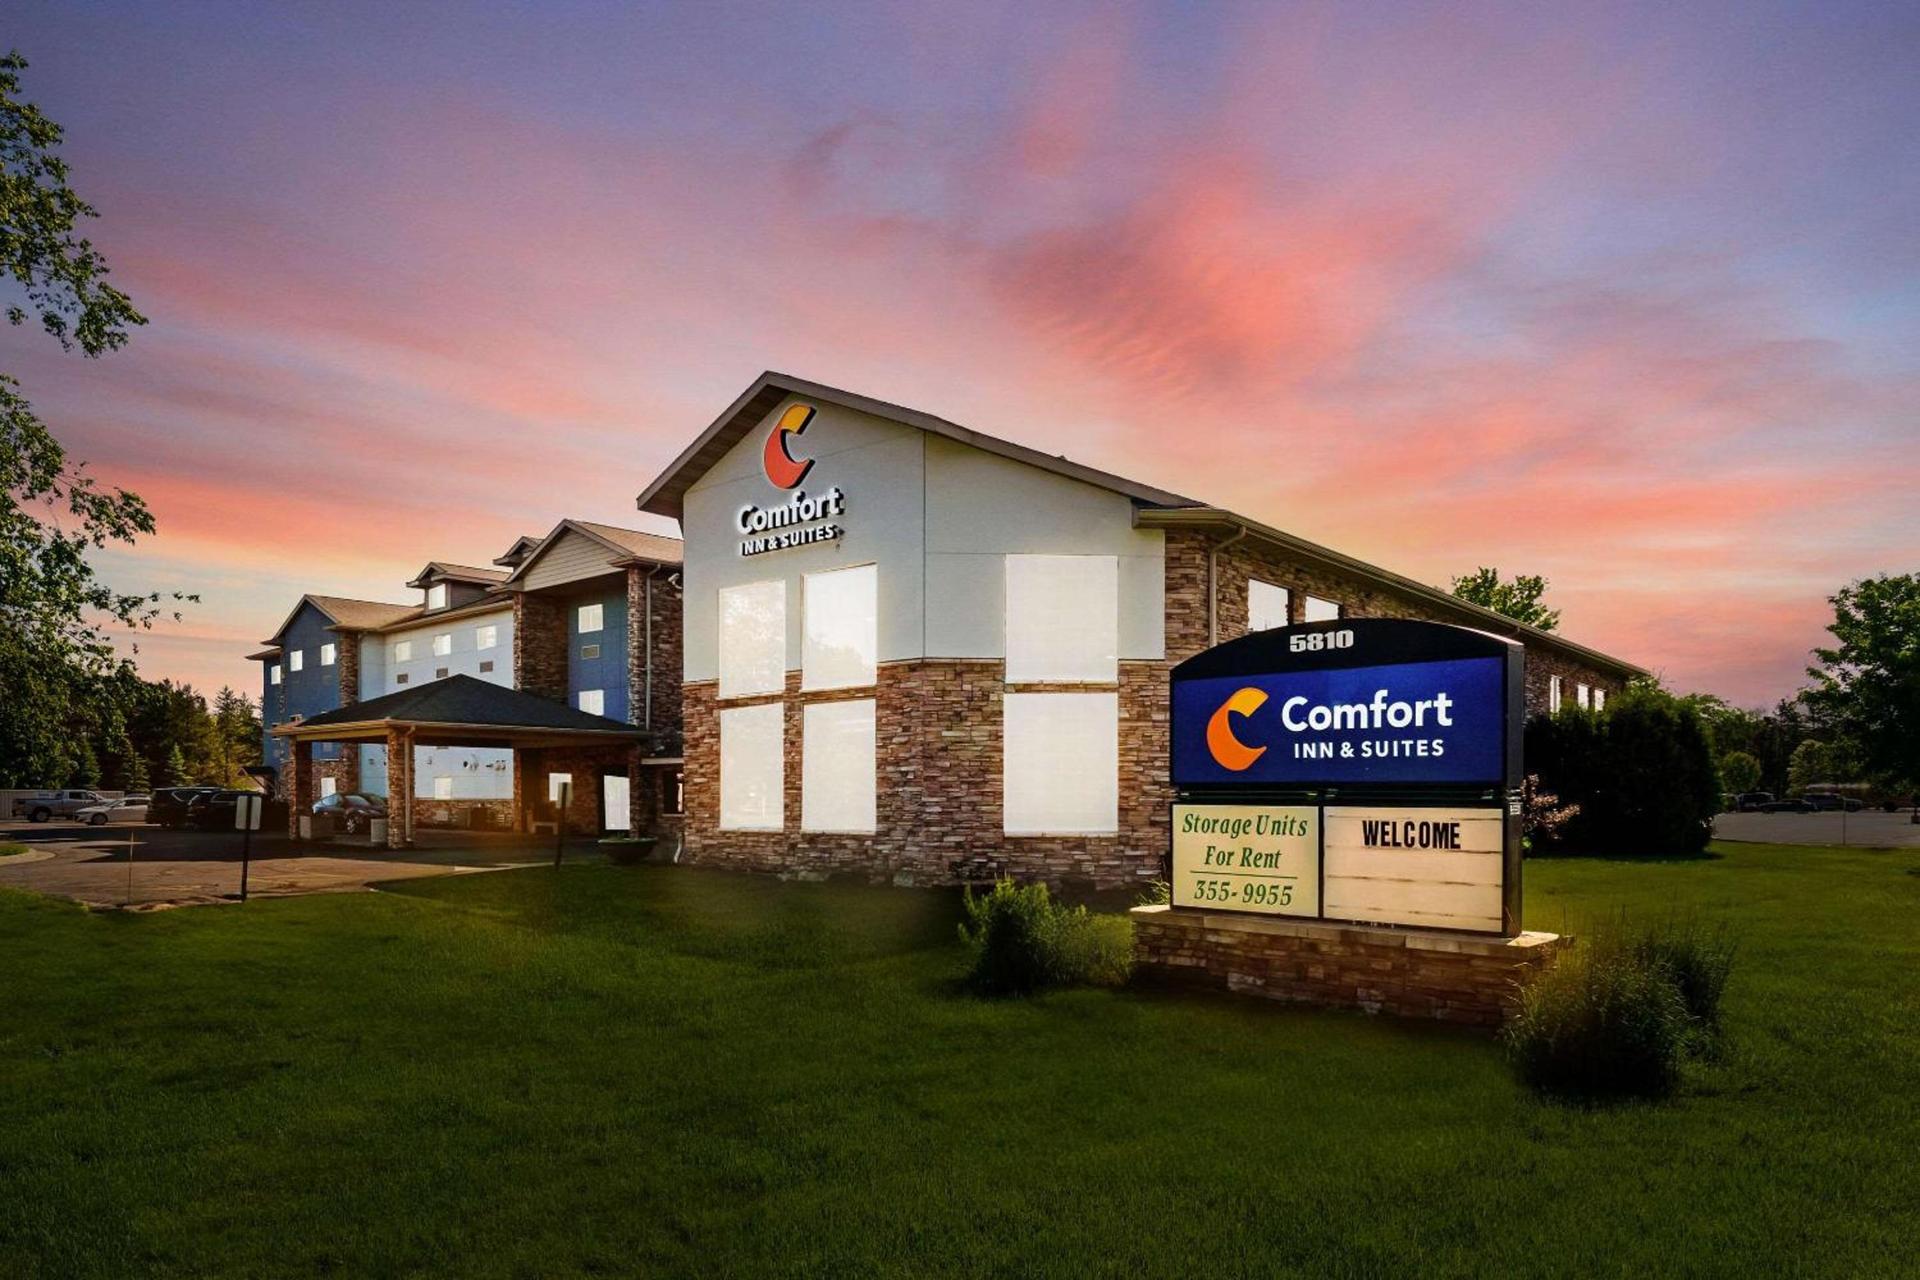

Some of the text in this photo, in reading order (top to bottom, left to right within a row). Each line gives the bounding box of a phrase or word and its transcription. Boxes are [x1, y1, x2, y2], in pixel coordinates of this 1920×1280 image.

[737, 487, 843, 535] Comfort
[740, 524, 836, 556] INN & SUITES
[1290, 629, 1354, 652] 5810
[1282, 689, 1453, 732] Comfort
[1294, 739, 1444, 759] INN & SUITES
[1182, 813, 1308, 839] Storage Units
[1362, 820, 1461, 849] WELCOME
[1204, 845, 1282, 869] For Rent
[1193, 879, 1293, 905] 355-9955
